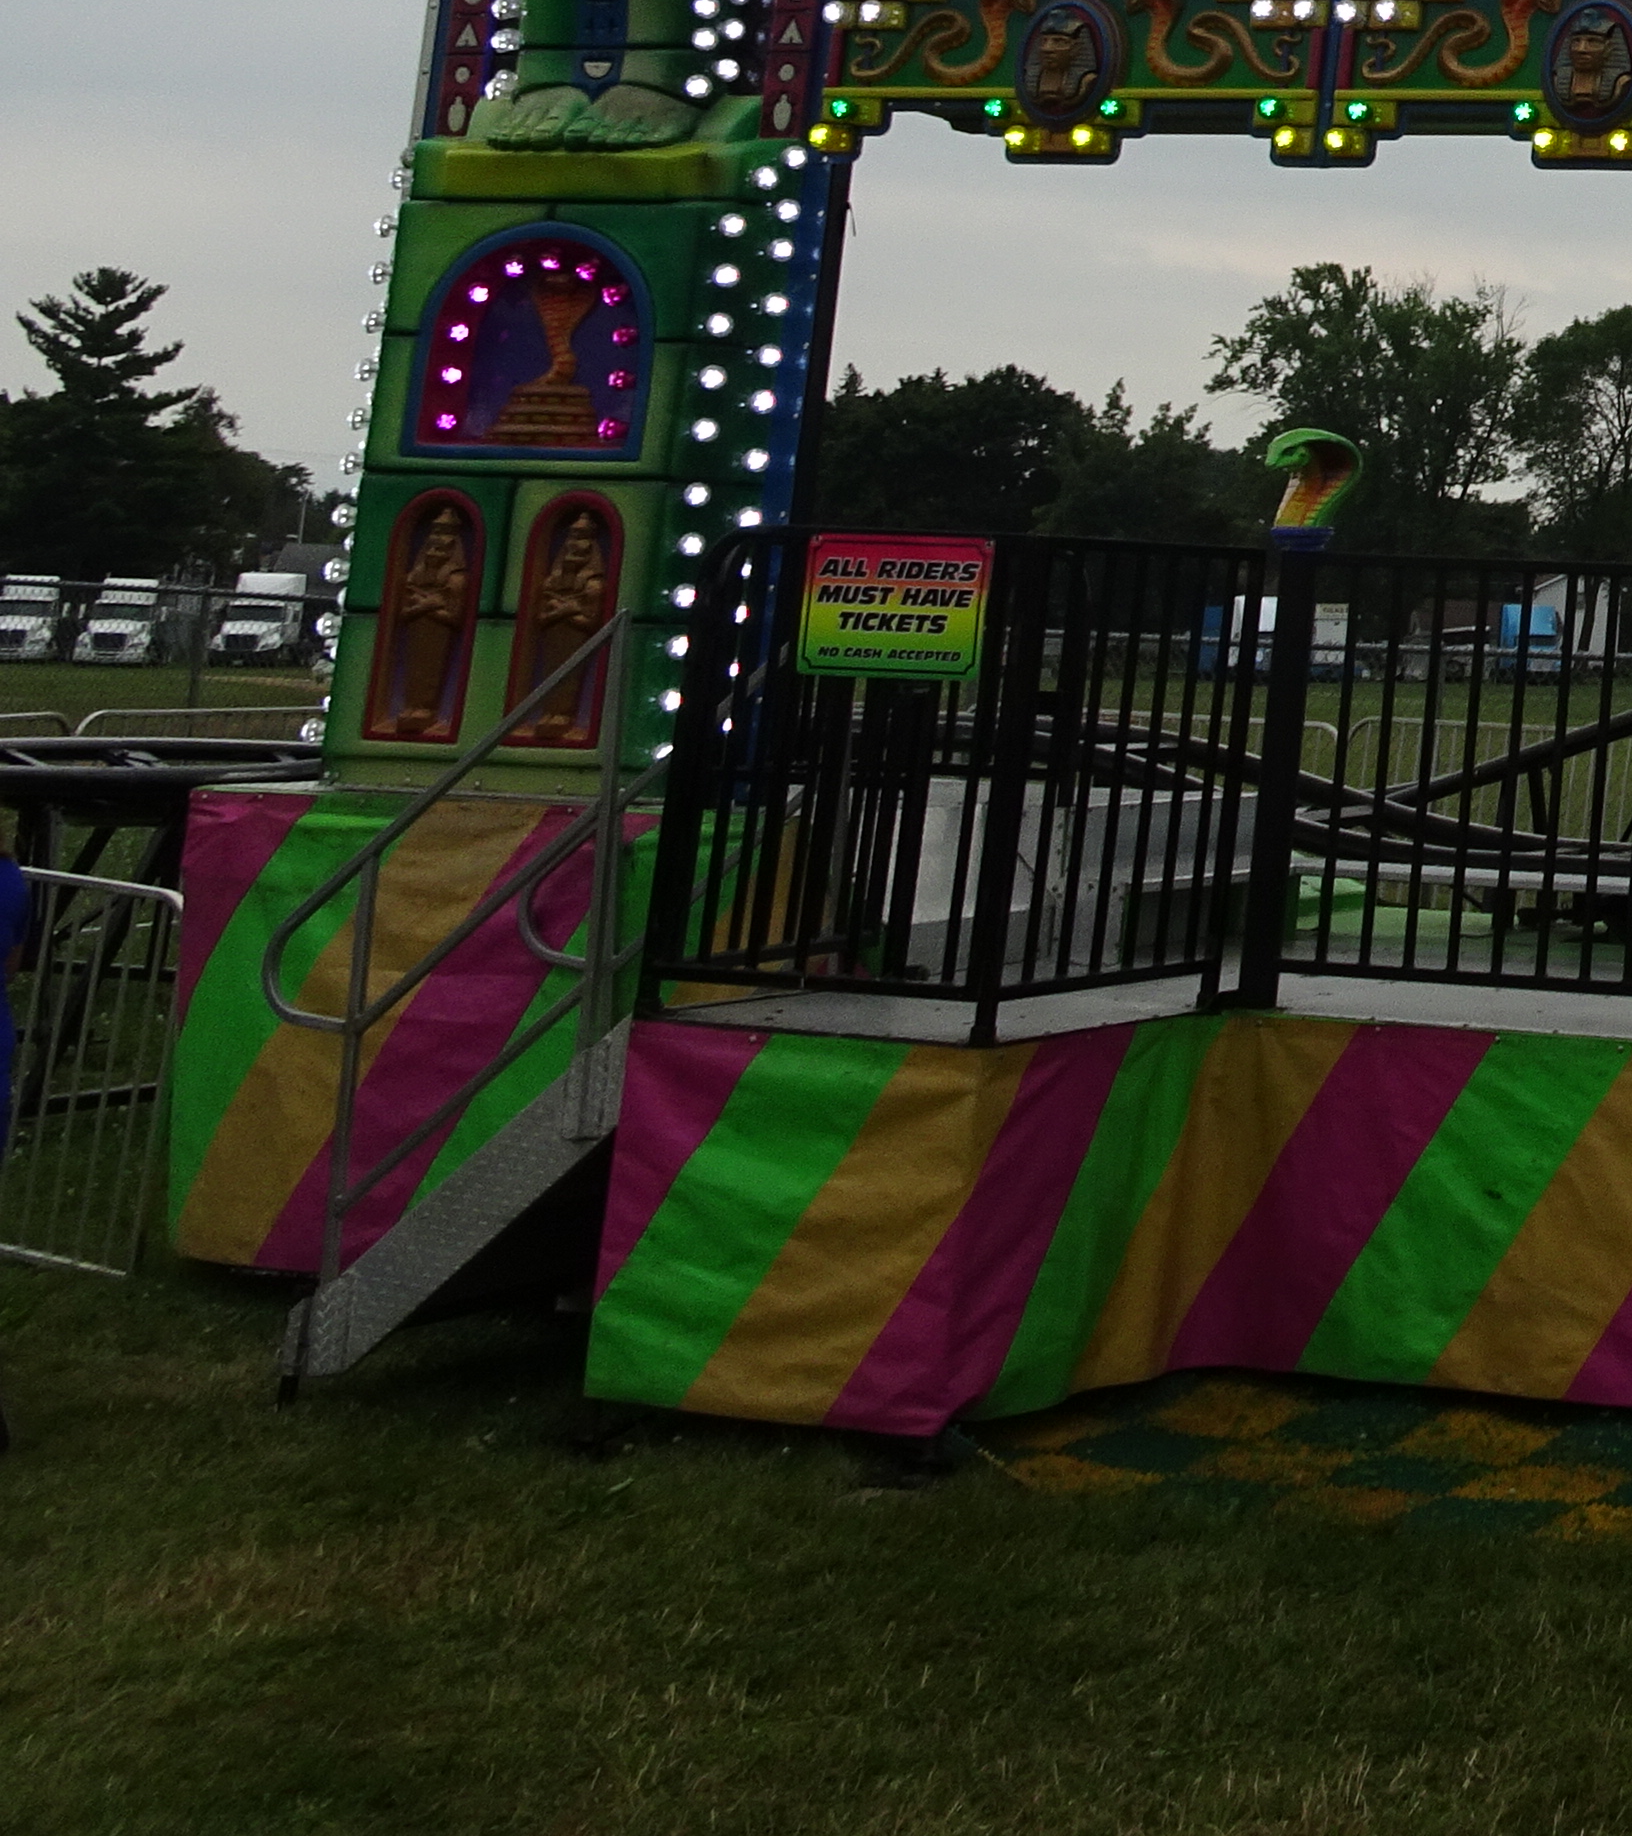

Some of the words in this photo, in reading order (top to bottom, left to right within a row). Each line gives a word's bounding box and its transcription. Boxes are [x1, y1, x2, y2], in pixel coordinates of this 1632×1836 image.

[818, 557, 869, 578] ALL
[876, 558, 982, 582] RIDERS
[817, 584, 895, 605] MUST
[900, 587, 975, 609] HAVE
[838, 611, 948, 635] TICKETS
[818, 646, 839, 657] NO
[844, 647, 882, 659] CASH
[887, 649, 962, 662] ACCEPTED
